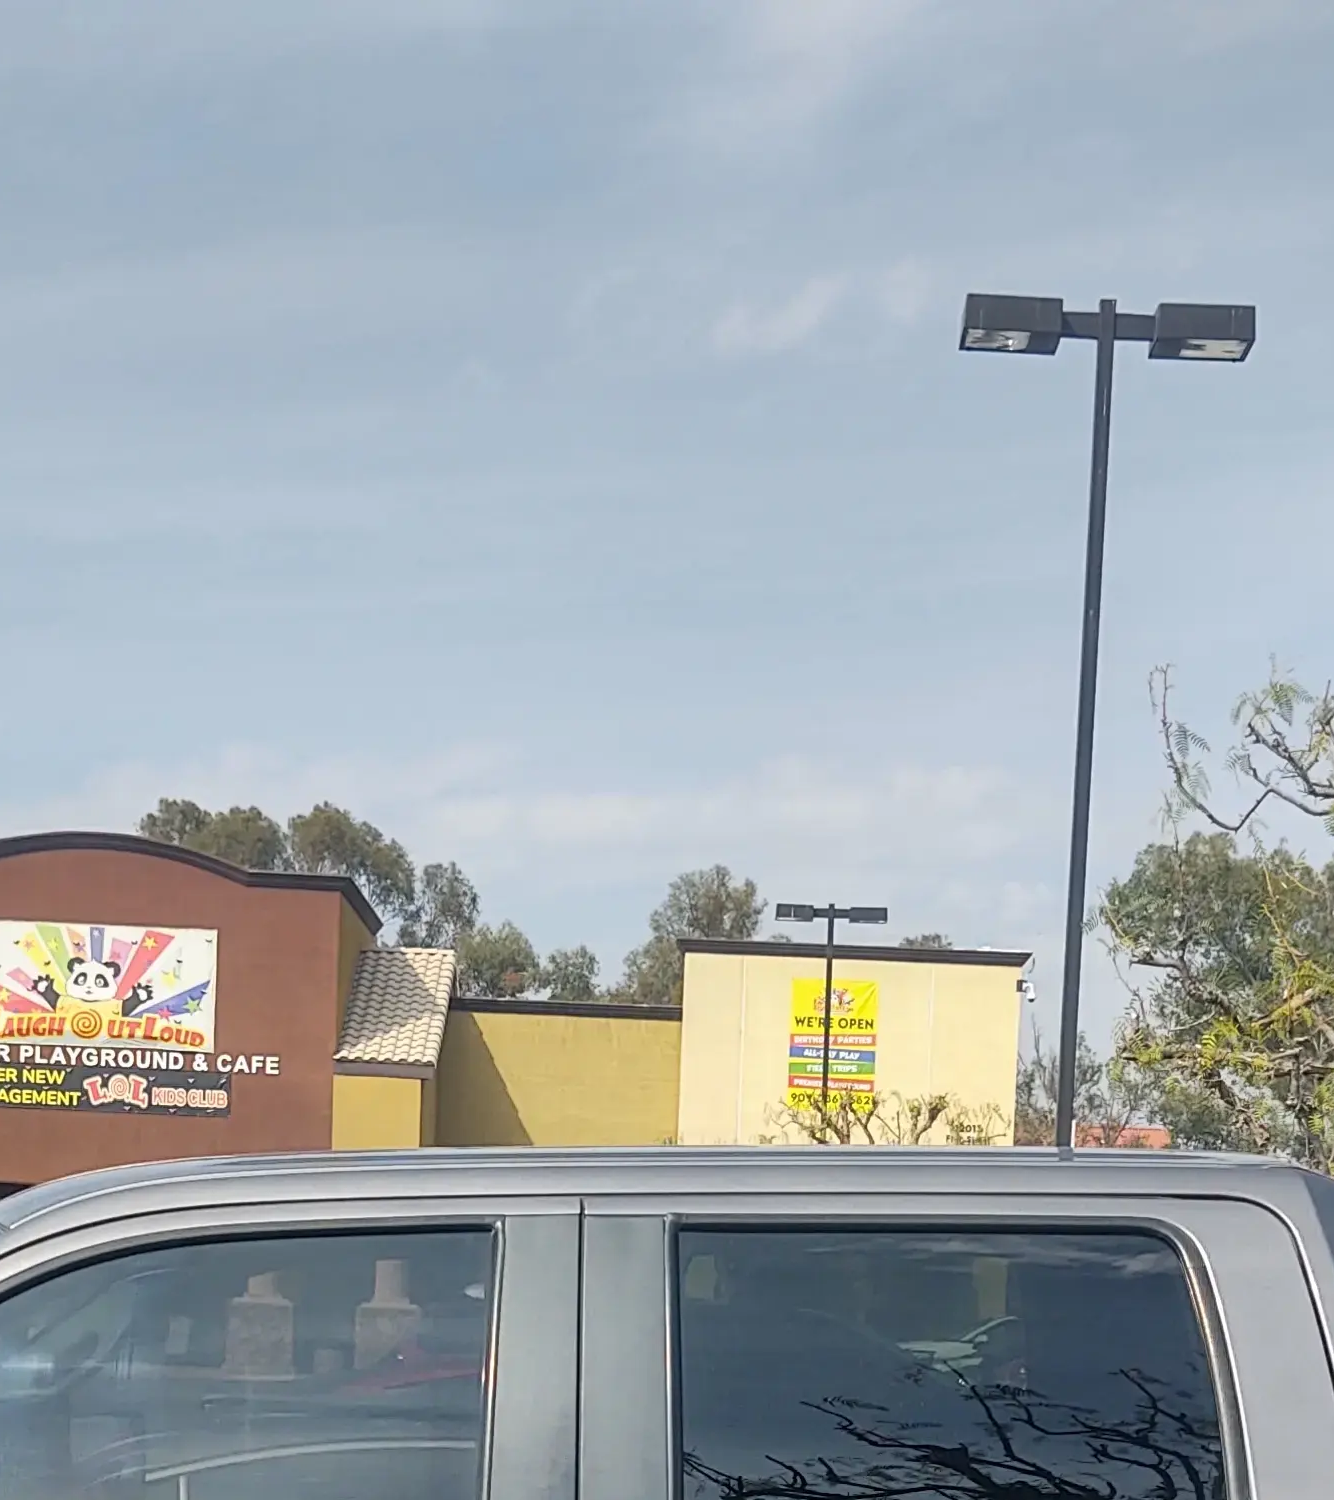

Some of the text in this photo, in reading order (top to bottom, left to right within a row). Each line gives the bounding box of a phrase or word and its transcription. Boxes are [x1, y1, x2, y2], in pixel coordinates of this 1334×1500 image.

[838, 1018, 874, 1030] OPEN
[143, 1016, 205, 1048] LOUD
[837, 1036, 873, 1044] PARTIES
[20, 1043, 183, 1070] PLAYGROUND
[193, 1052, 208, 1072] &
[217, 1054, 280, 1075] CAFE
[839, 1050, 860, 1060] PLAY
[22, 1069, 66, 1084] NEW
[152, 1088, 186, 1106] KIDS
[188, 1089, 228, 1108] CLUB
